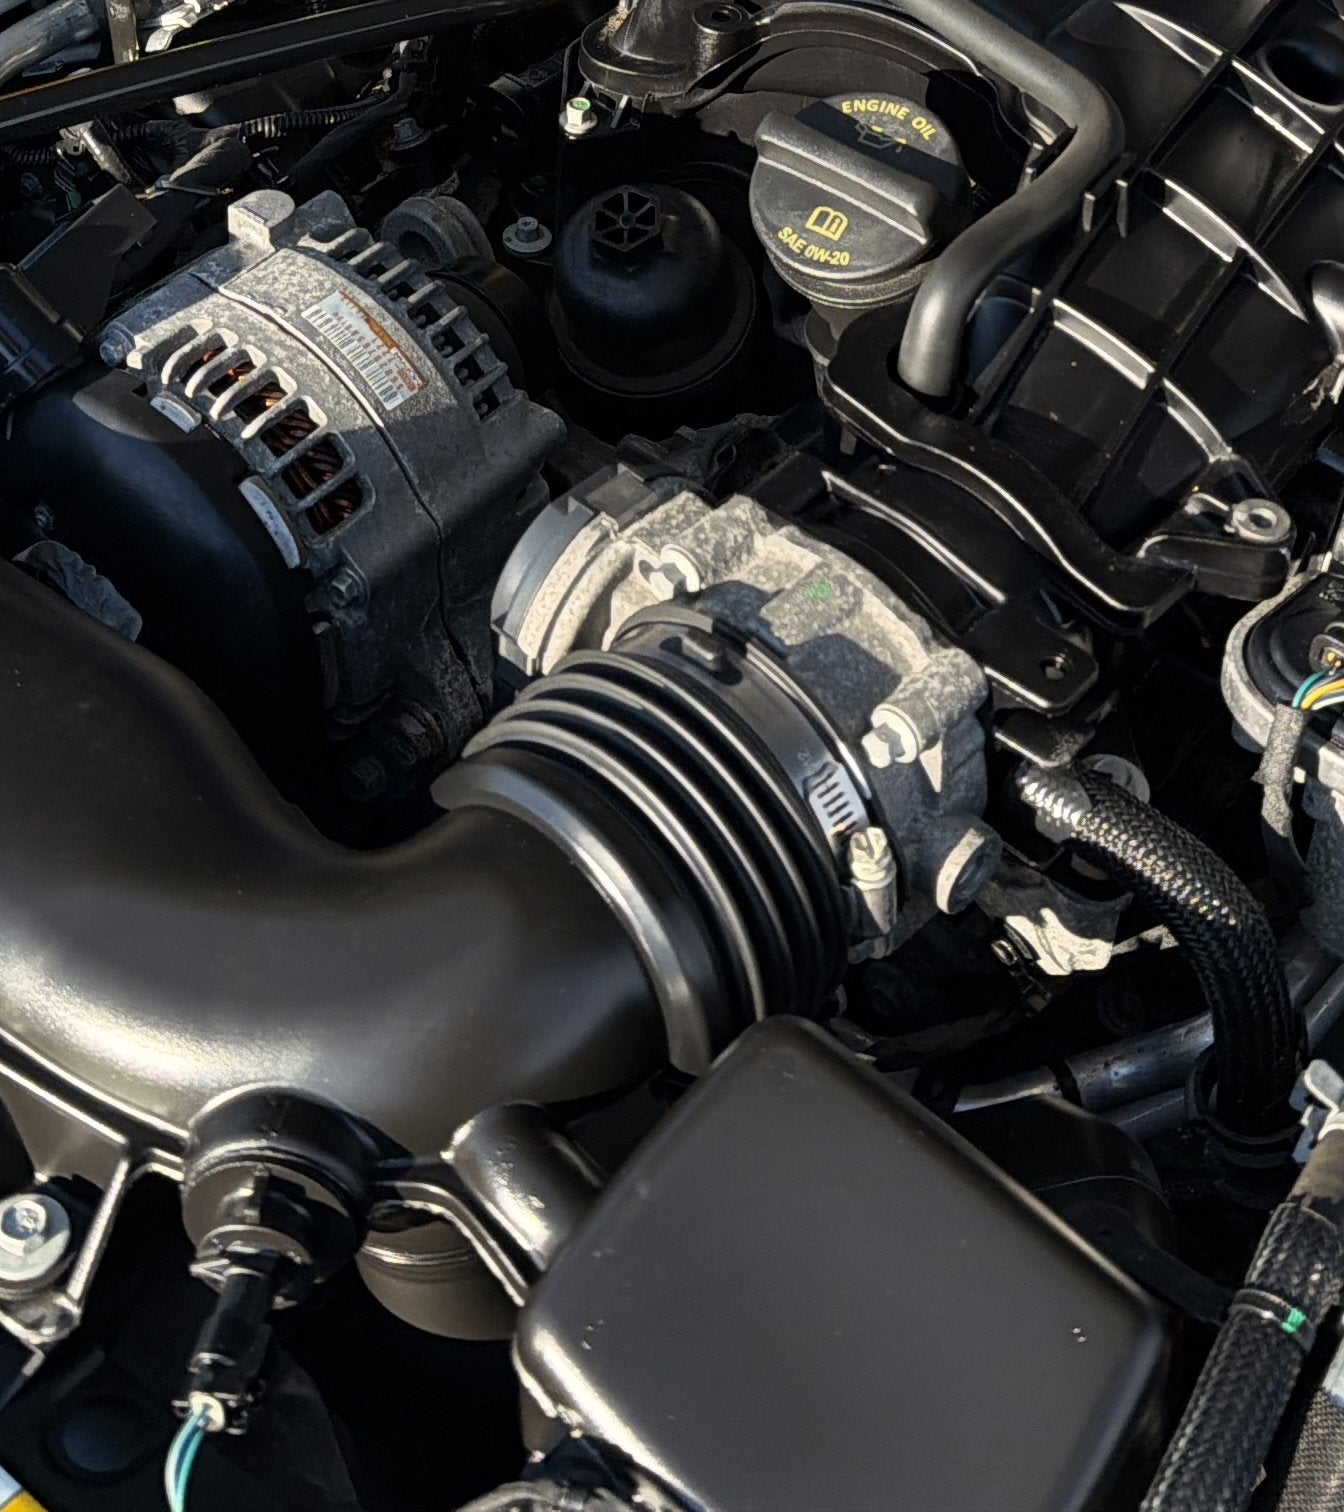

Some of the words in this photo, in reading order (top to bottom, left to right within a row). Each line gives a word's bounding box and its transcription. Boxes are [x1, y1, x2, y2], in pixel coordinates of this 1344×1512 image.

[841, 98, 910, 121] ENGINE
[911, 116, 939, 141] OIL
[777, 226, 806, 254] SAE
[804, 242, 850, 267] 0W-20
